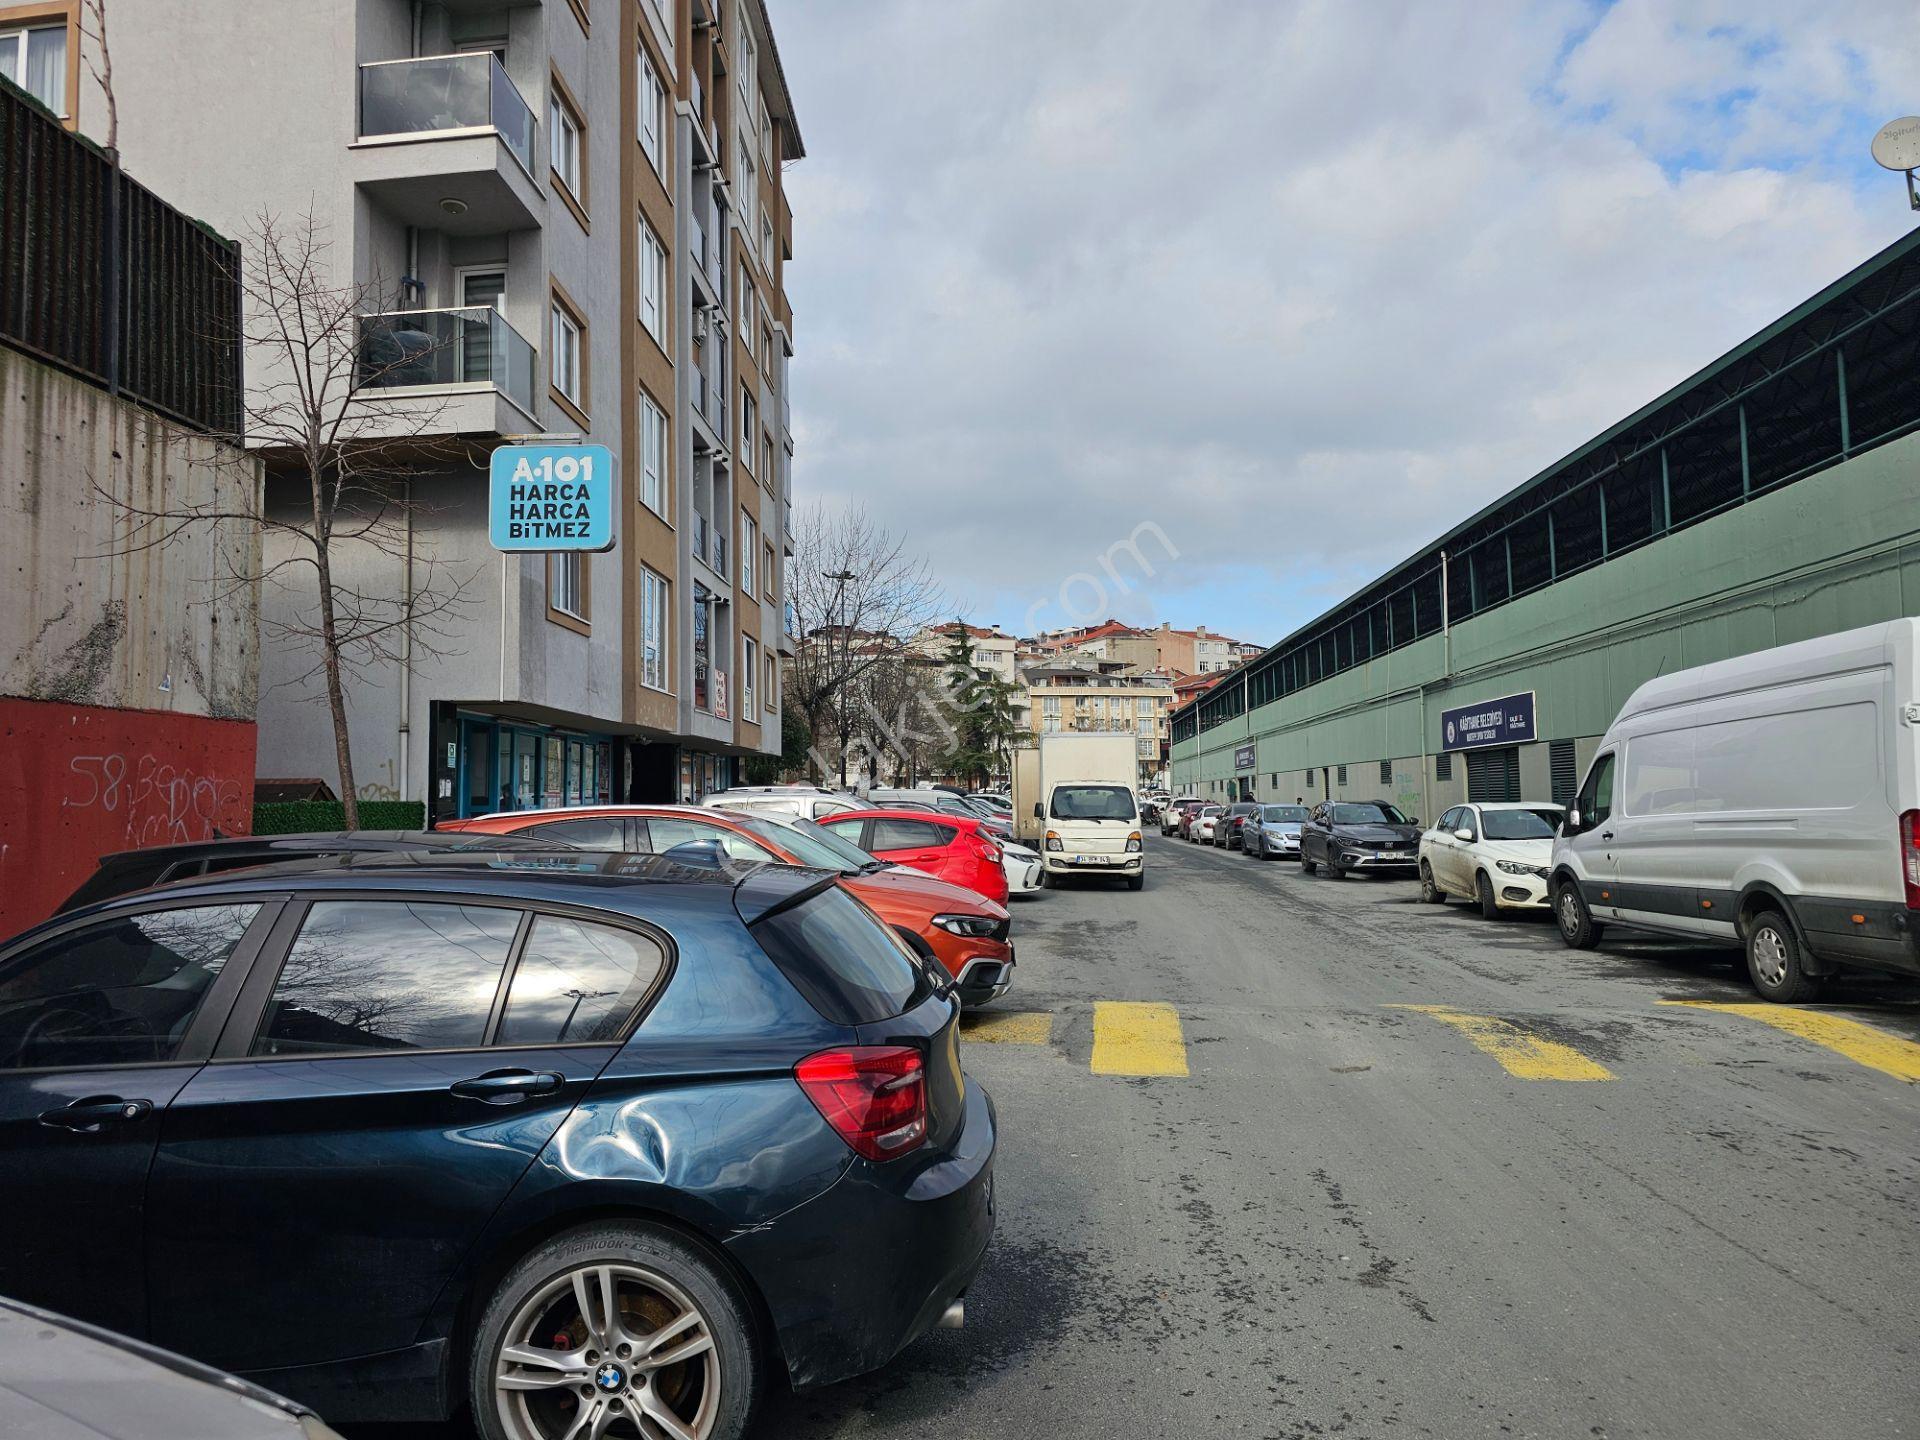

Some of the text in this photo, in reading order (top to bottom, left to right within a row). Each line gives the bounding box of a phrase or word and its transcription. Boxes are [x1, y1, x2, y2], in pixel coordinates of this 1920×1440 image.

[510, 484, 591, 501] HARCA
[510, 503, 590, 520] HARCA
[70, 754, 126, 811] 58
